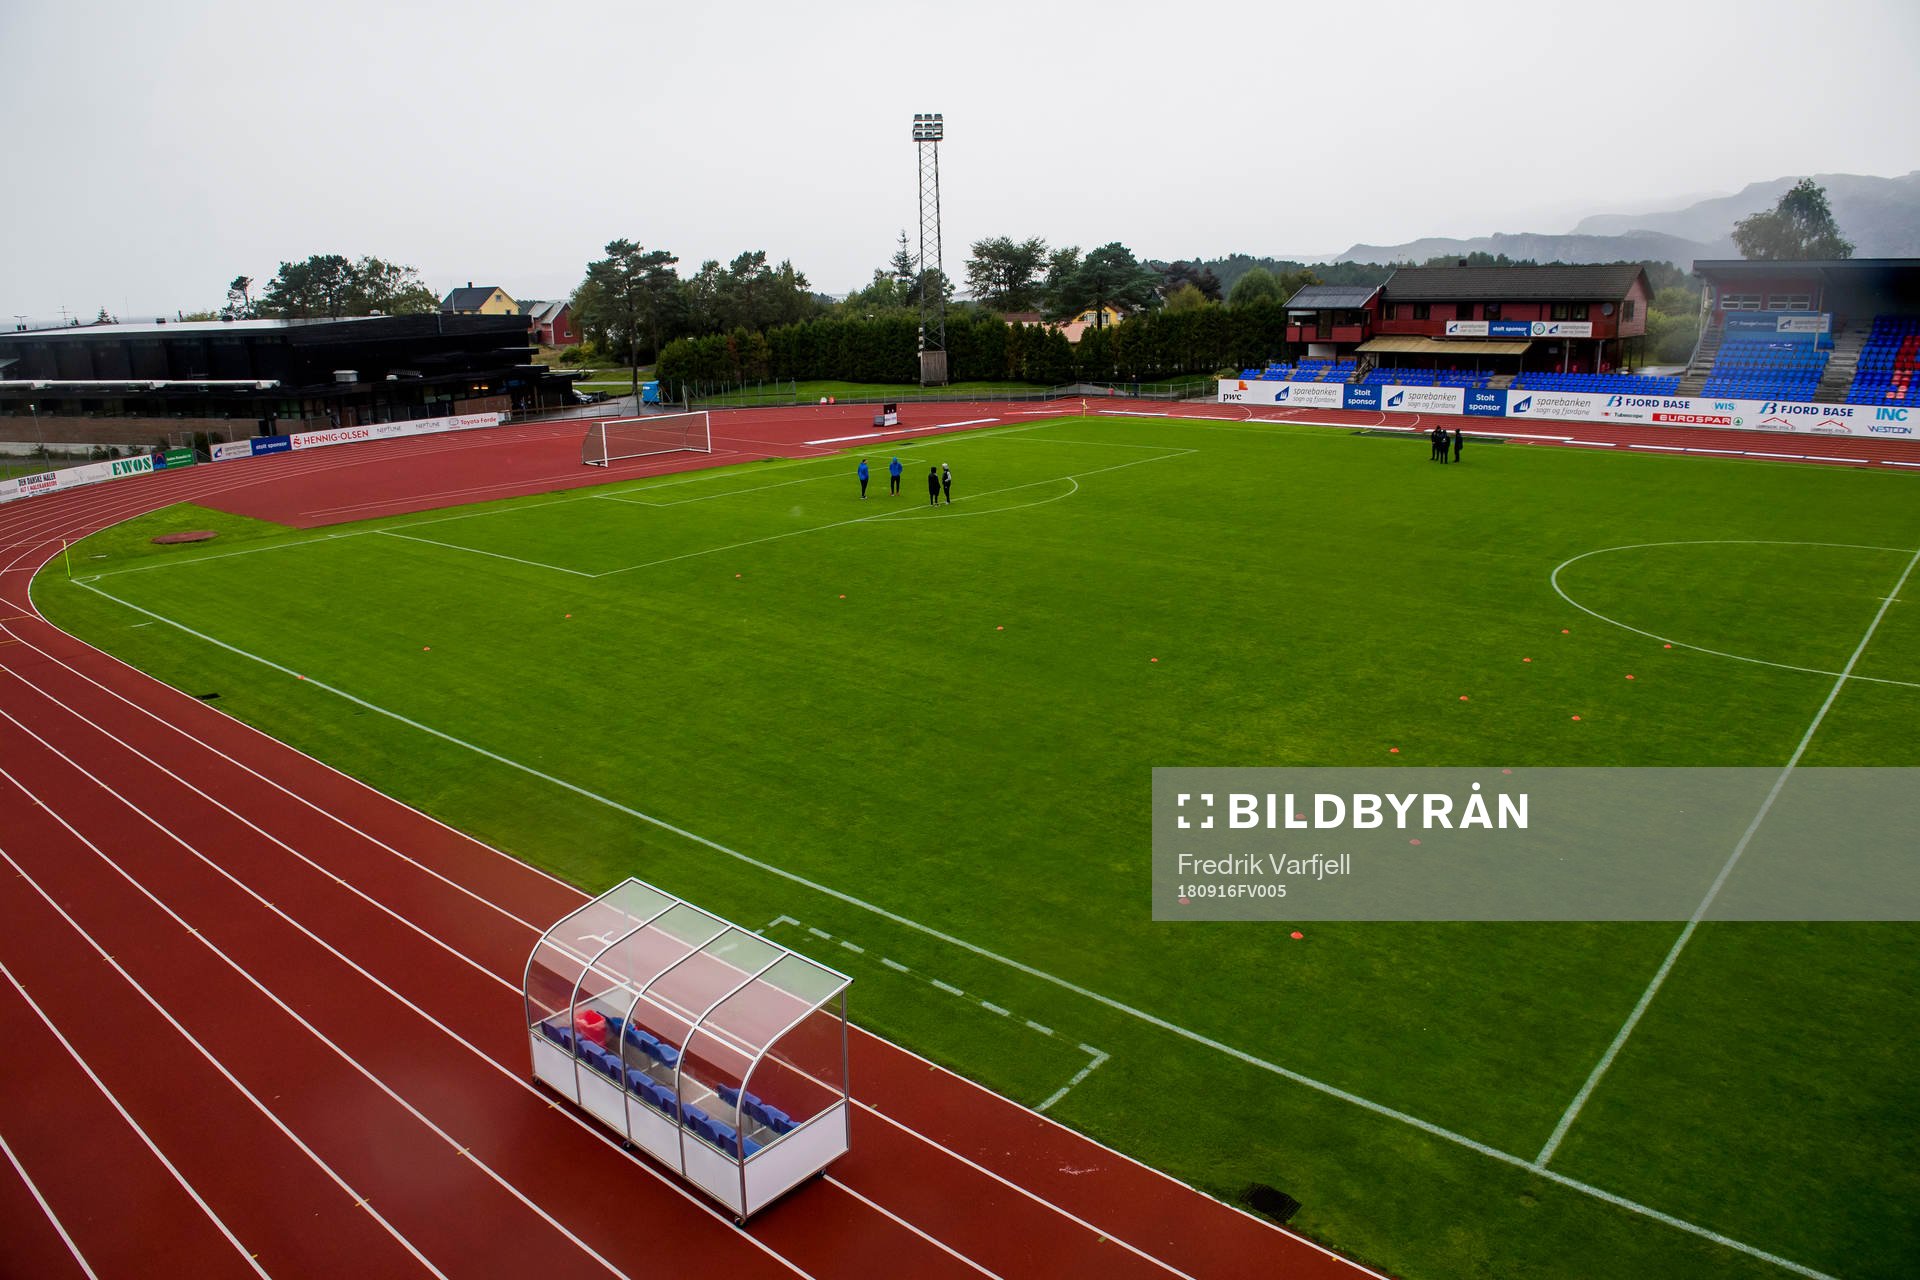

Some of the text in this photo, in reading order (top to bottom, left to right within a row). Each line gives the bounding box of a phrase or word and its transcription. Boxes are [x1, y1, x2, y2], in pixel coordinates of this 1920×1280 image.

[1293, 387, 1337, 396] sparebanken
[1354, 388, 1371, 396] Stolt
[1408, 391, 1457, 401] sparebanken
[1223, 392, 1242, 402] pwc
[1348, 397, 1376, 406] sponsor
[1476, 393, 1494, 401] Stolt
[1469, 403, 1500, 412] sponsor
[1536, 398, 1592, 408] sparebanken
[1626, 398, 1690, 409] FJORD BASE
[1714, 402, 1735, 411] WIS
[1551, 408, 1560, 416] og
[1780, 405, 1854, 417] FJORD BASE
[1876, 408, 1909, 421] INC
[1659, 414, 1731, 425] EUROSPAR
[1868, 425, 1912, 434] WESTCON
[303, 429, 369, 445] HENNIG-OLSEN
[112, 457, 152, 476] EWOS
